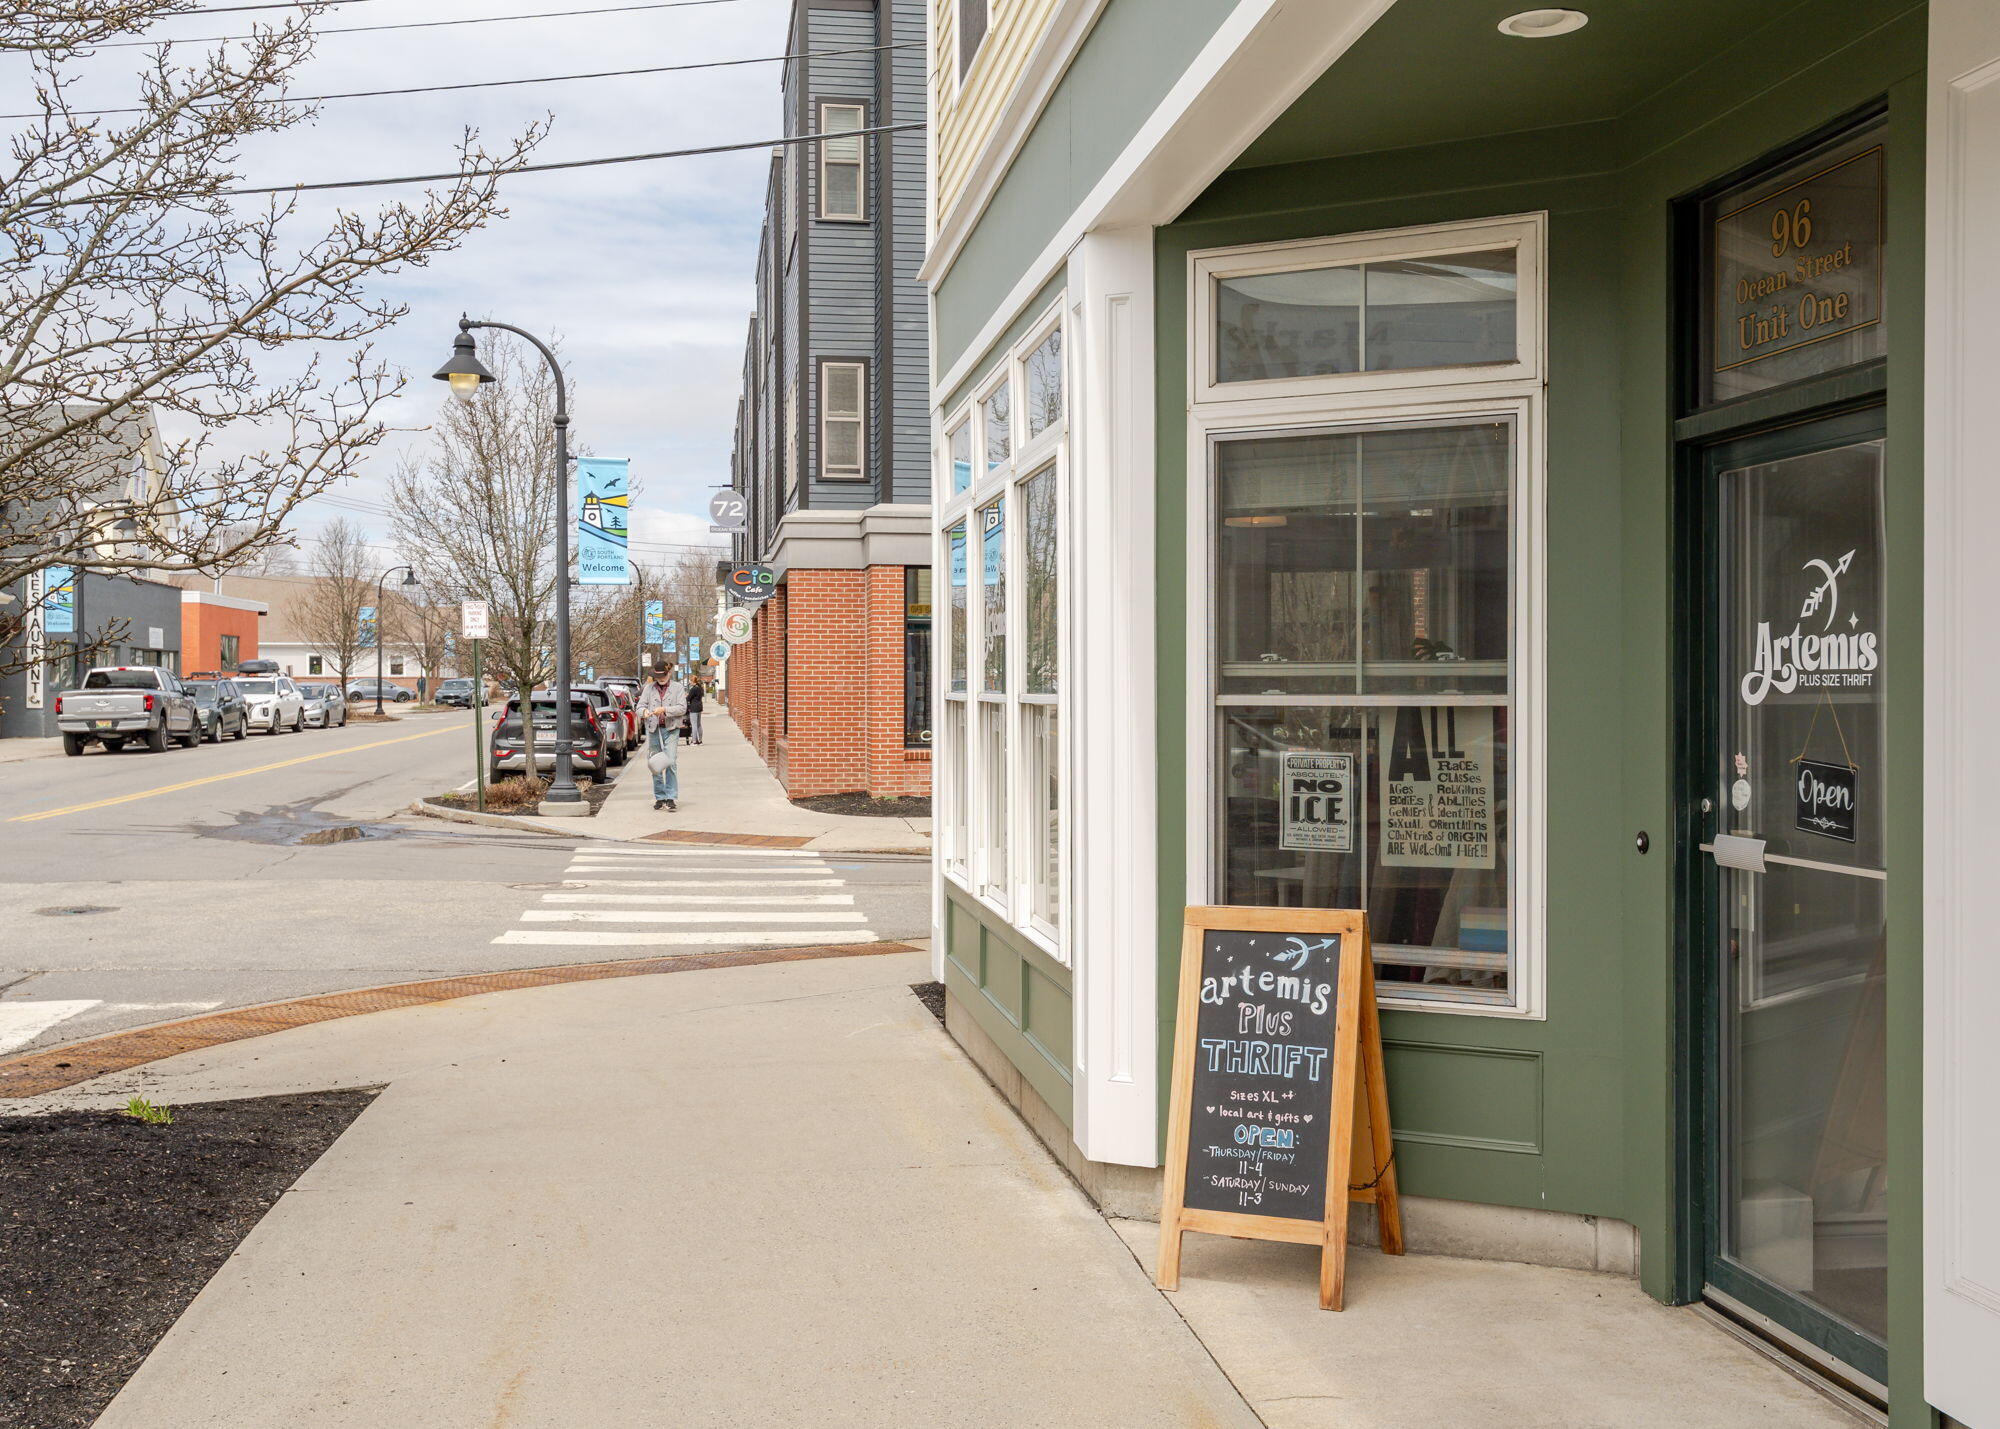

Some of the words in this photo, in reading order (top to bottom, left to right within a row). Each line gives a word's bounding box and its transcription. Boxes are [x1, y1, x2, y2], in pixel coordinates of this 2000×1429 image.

[1772, 199, 1812, 257] 96
[1736, 270, 1787, 304] Ocean
[1794, 241, 1852, 284] Street
[1739, 305, 1790, 350] Unit
[1800, 292, 1849, 330] One
[713, 500, 744, 517] 72
[582, 563, 625, 572] Welcome
[1741, 621, 1878, 706] Artemis
[1799, 674, 1821, 686] PLUS
[1822, 674, 1840, 686] SIZE
[1842, 673, 1872, 686] THRIFT
[1388, 706, 1465, 781] ALL
[1290, 758, 1315, 769] PRIVATE
[1315, 758, 1344, 769] PROPERTY
[1291, 771, 1345, 779] ABSOLUTELY
[1293, 779, 1342, 793] NO
[1798, 769, 1854, 815] Open
[1290, 796, 1348, 825] I.C.E.
[1387, 842, 1405, 855] ARE
[1200, 965, 1332, 1016] artemis
[1238, 1002, 1293, 1036] Plus
[1201, 1038, 1328, 1081] THRIFT
[1262, 1091, 1279, 1103] XL
[1220, 1105, 1242, 1118] local
[1247, 1110, 1264, 1120] art
[1275, 1113, 1300, 1126] gifts
[1239, 1161, 1263, 1176] 11-4
[1239, 1191, 1262, 1206] 11-3
